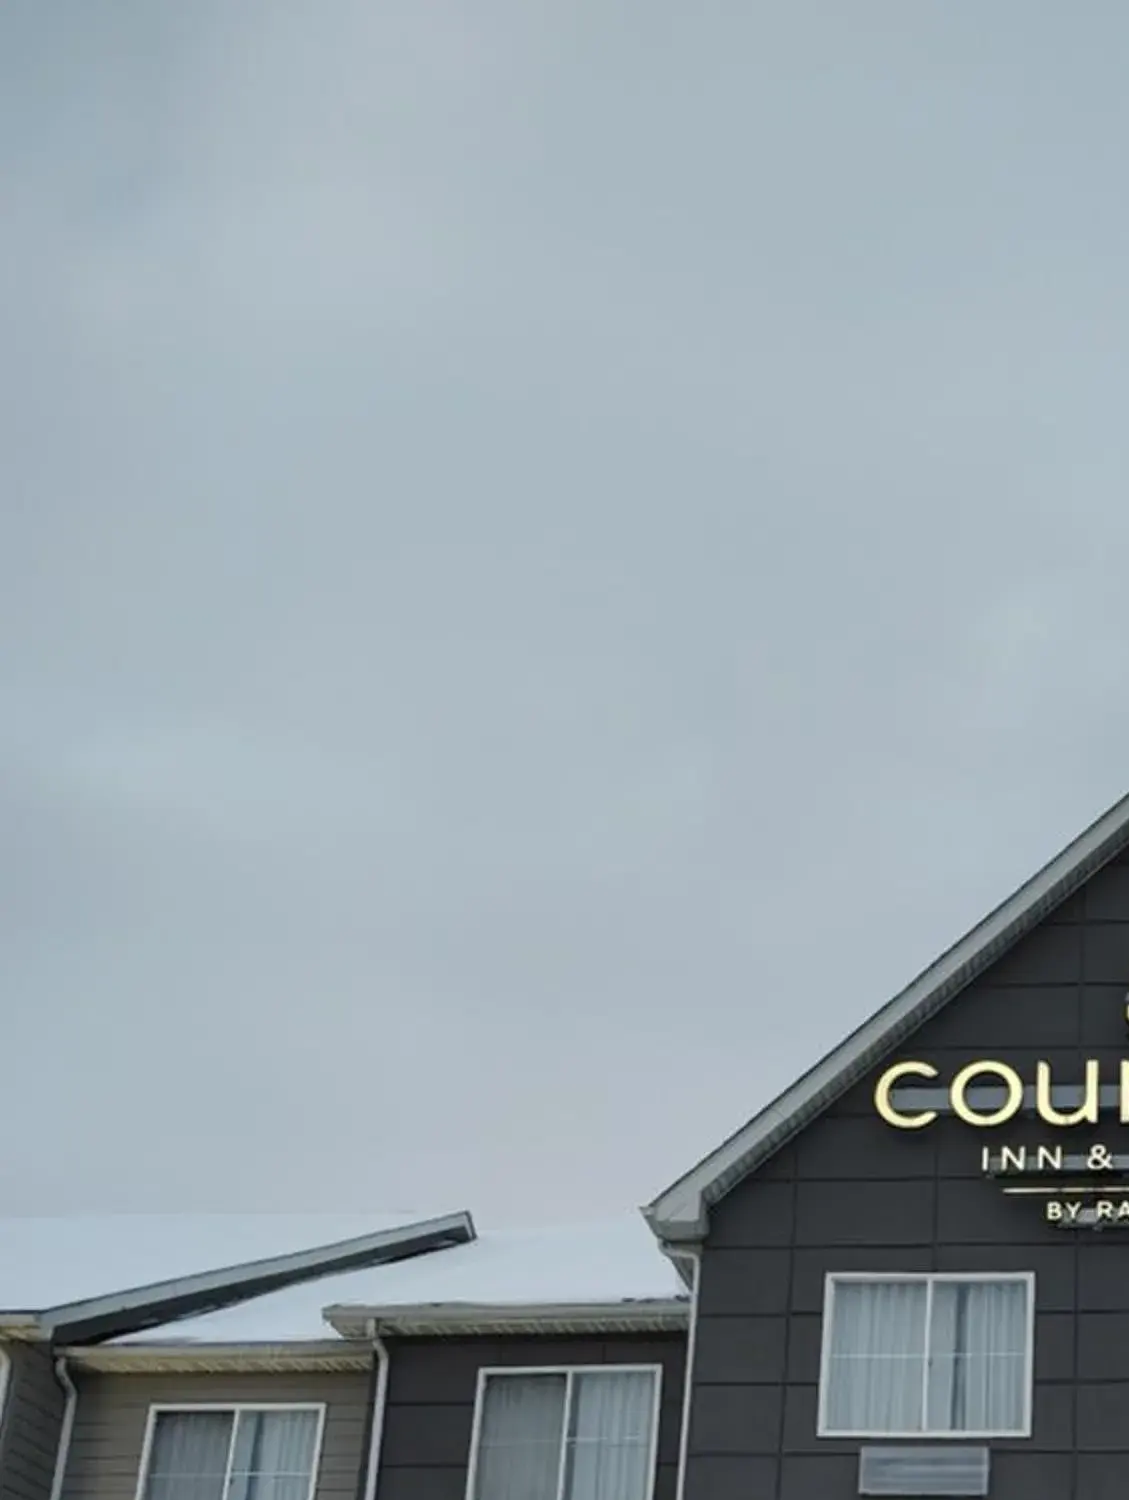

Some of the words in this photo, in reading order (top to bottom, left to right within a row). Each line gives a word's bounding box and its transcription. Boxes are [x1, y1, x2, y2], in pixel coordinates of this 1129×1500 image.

[982, 1146, 1062, 1170] INN
[1086, 1145, 1113, 1169] &
[1046, 1202, 1082, 1220] BY
